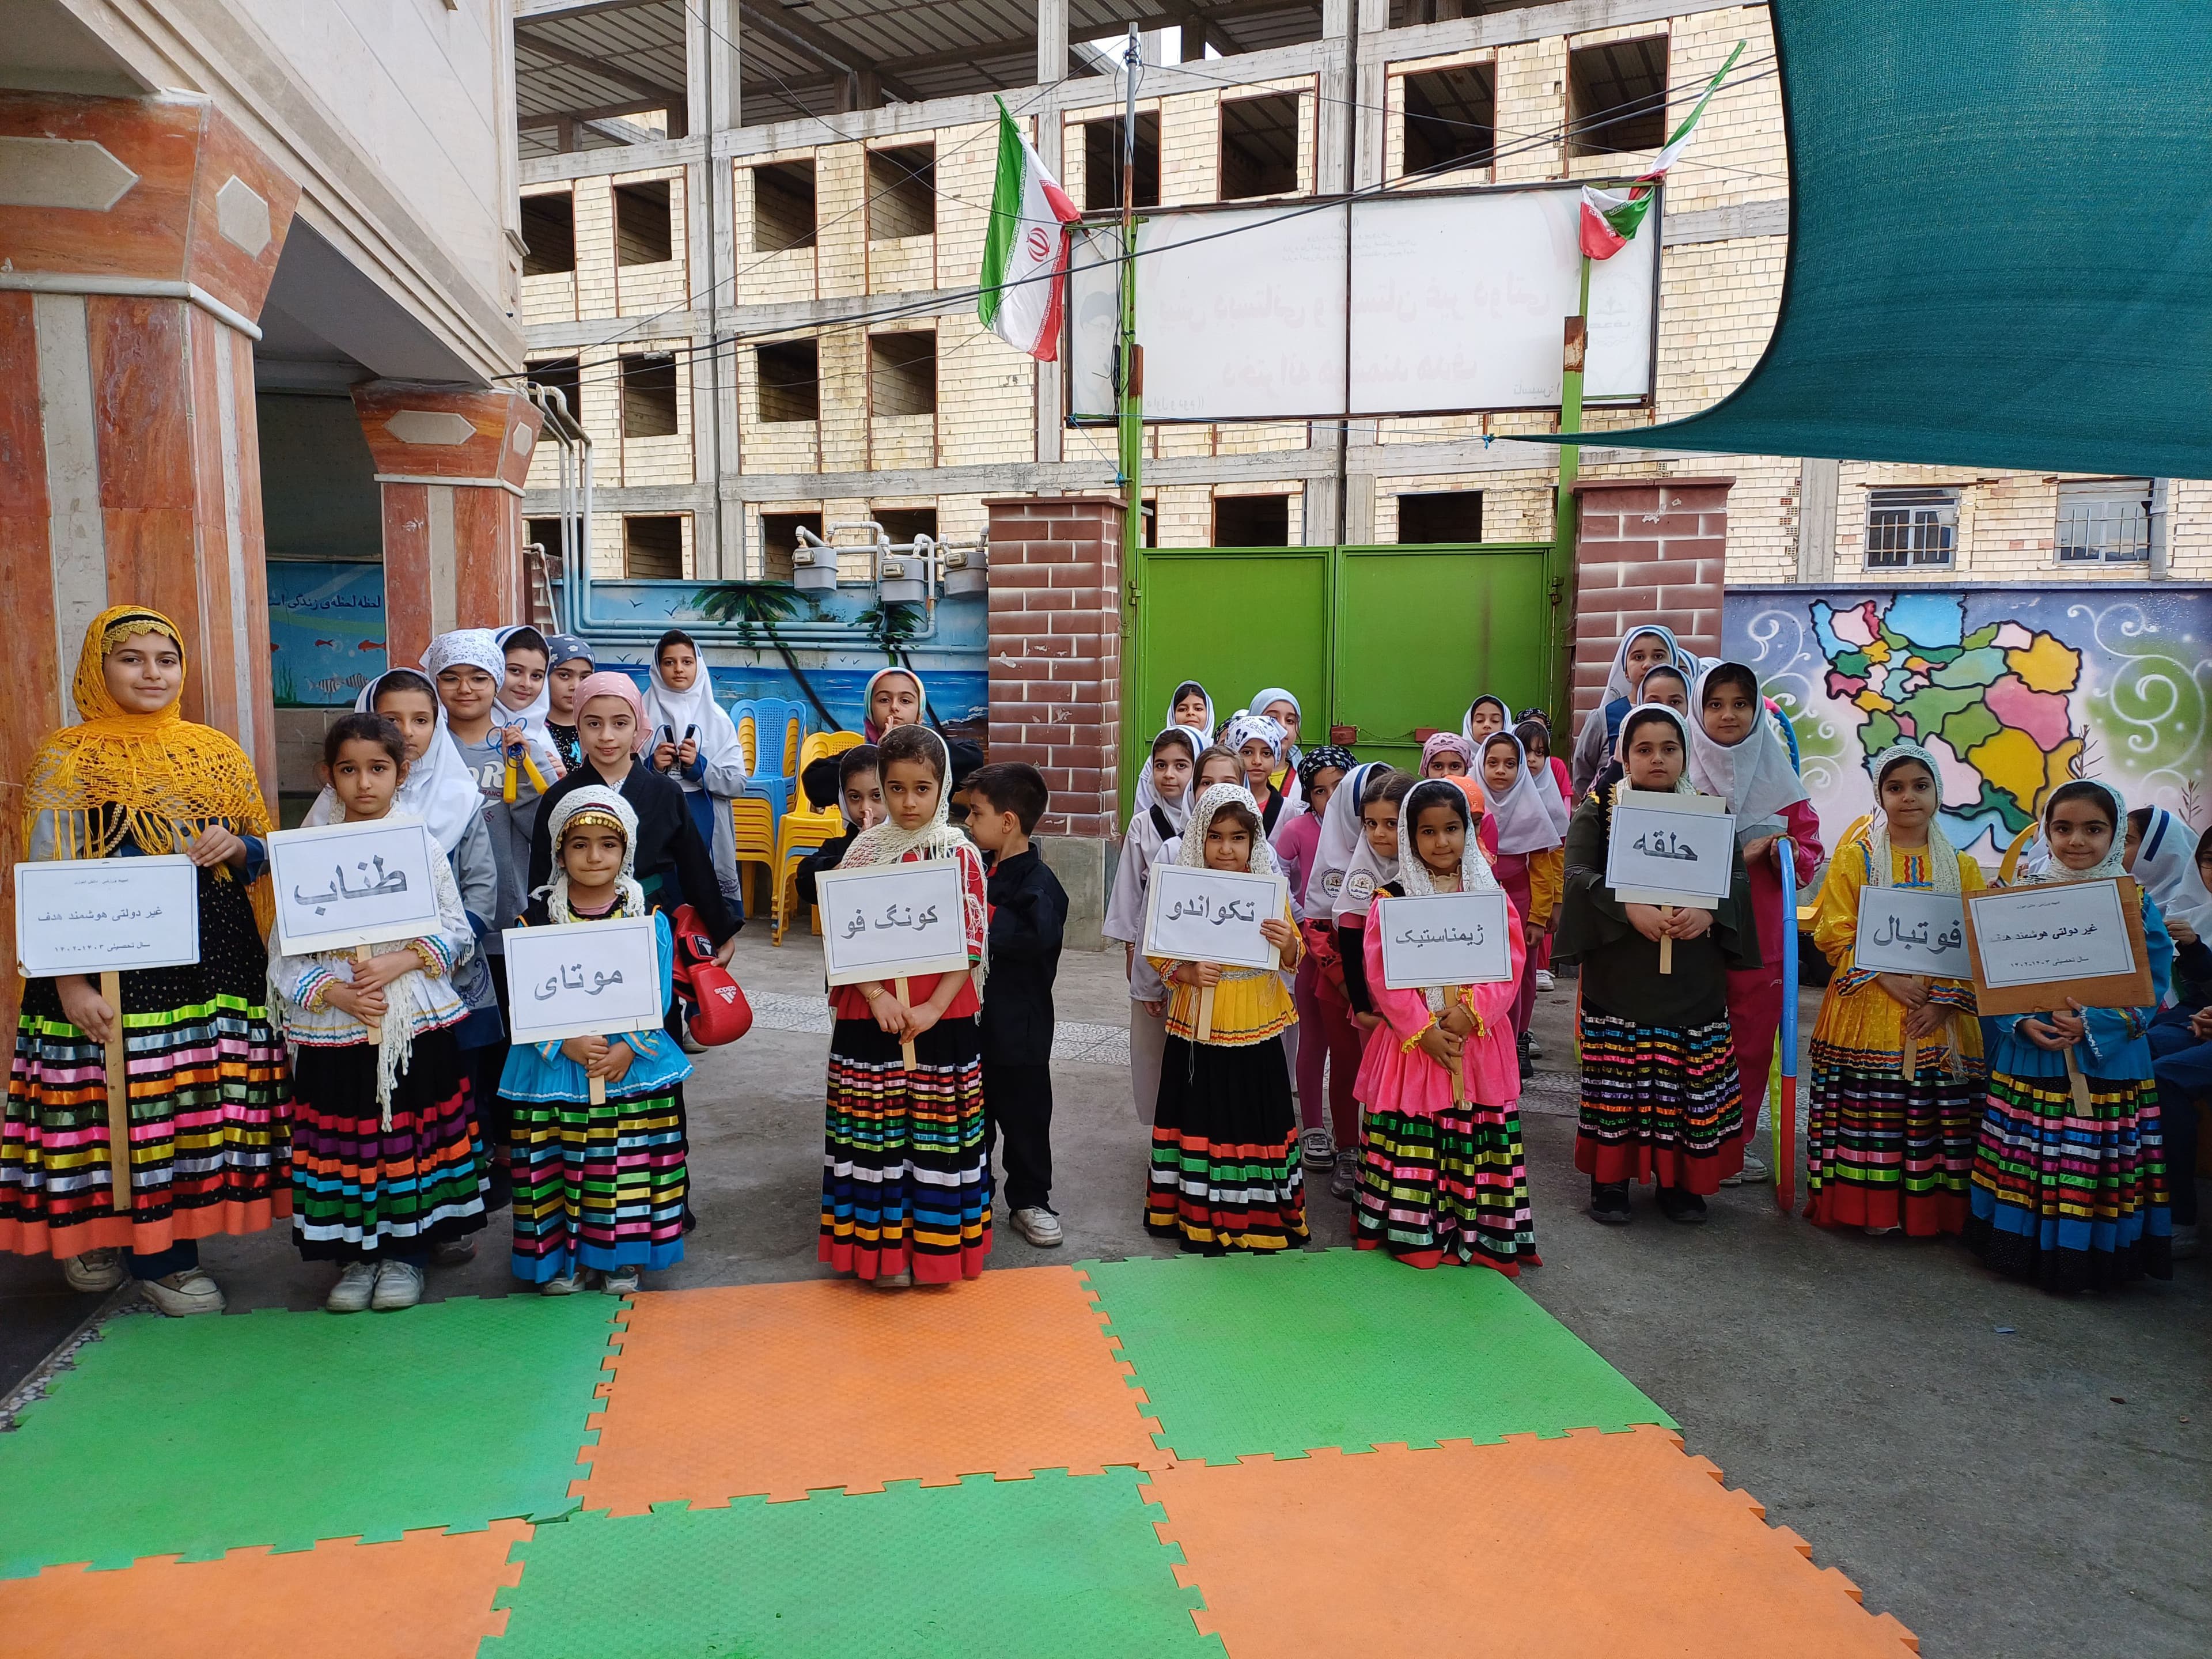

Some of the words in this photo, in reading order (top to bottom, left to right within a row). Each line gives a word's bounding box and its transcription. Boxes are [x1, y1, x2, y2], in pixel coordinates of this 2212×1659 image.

[287, 594, 317, 611] زندگی
[358, 594, 381, 608] لحظه
[1633, 830, 1698, 862] حلقه
[293, 854, 408, 916] طناب
[38, 912, 62, 922] هدف
[69, 910, 107, 921] هوشمند
[112, 908, 141, 921] دولتی
[146, 906, 163, 918] غیر
[874, 904, 938, 931] کونگ
[1166, 896, 1255, 926] تکواندو
[840, 908, 866, 940] فو
[2081, 923, 2097, 935] غیر
[1395, 924, 1484, 949] ژیمناستیک
[1873, 914, 1962, 955] فوتبال
[2016, 930, 2048, 940] هوشمند
[2052, 927, 2078, 940] دولتی
[107, 942, 134, 952] تحصیلی
[2052, 957, 2075, 967] تحصیلی
[535, 963, 623, 1001] موتای
